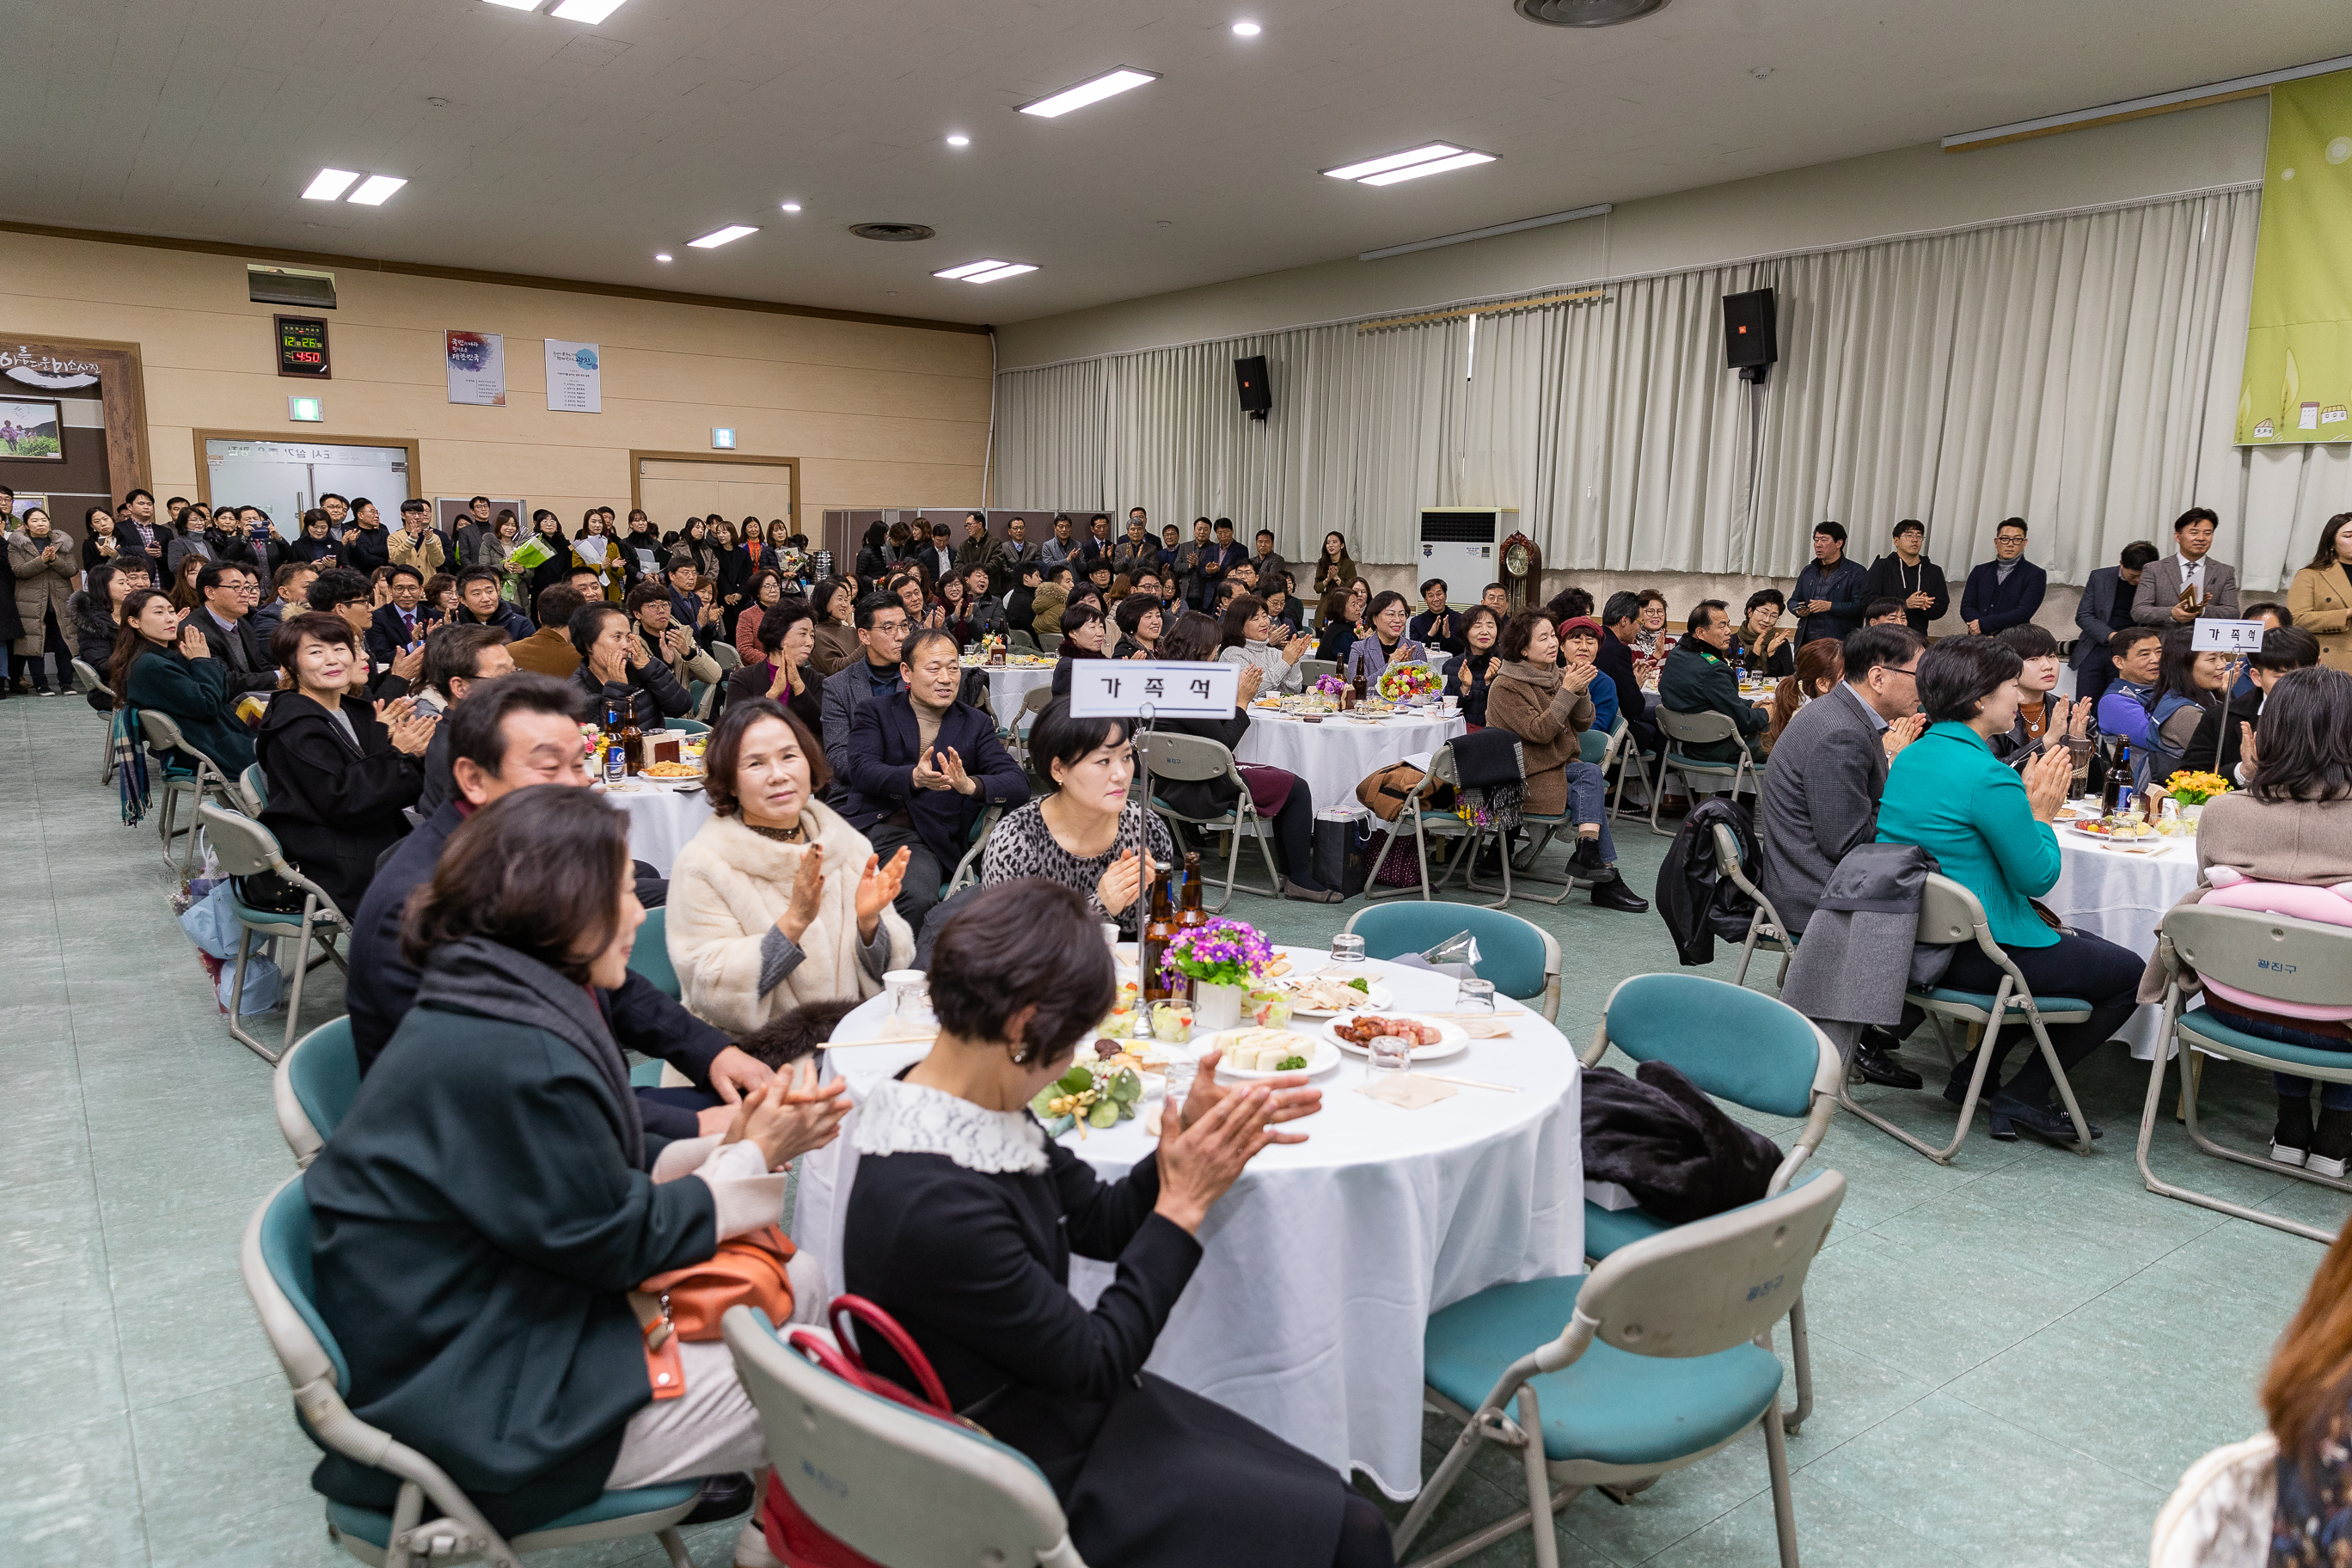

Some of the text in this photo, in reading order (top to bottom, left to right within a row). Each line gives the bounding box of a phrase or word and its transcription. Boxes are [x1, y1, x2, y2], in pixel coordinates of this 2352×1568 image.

[285, 336, 294, 346] 12
[302, 338, 315, 347] 26
[296, 352, 320, 363] 4:50
[451, 352, 480, 363] 대한민국
[2257, 959, 2297, 975] 광진구
